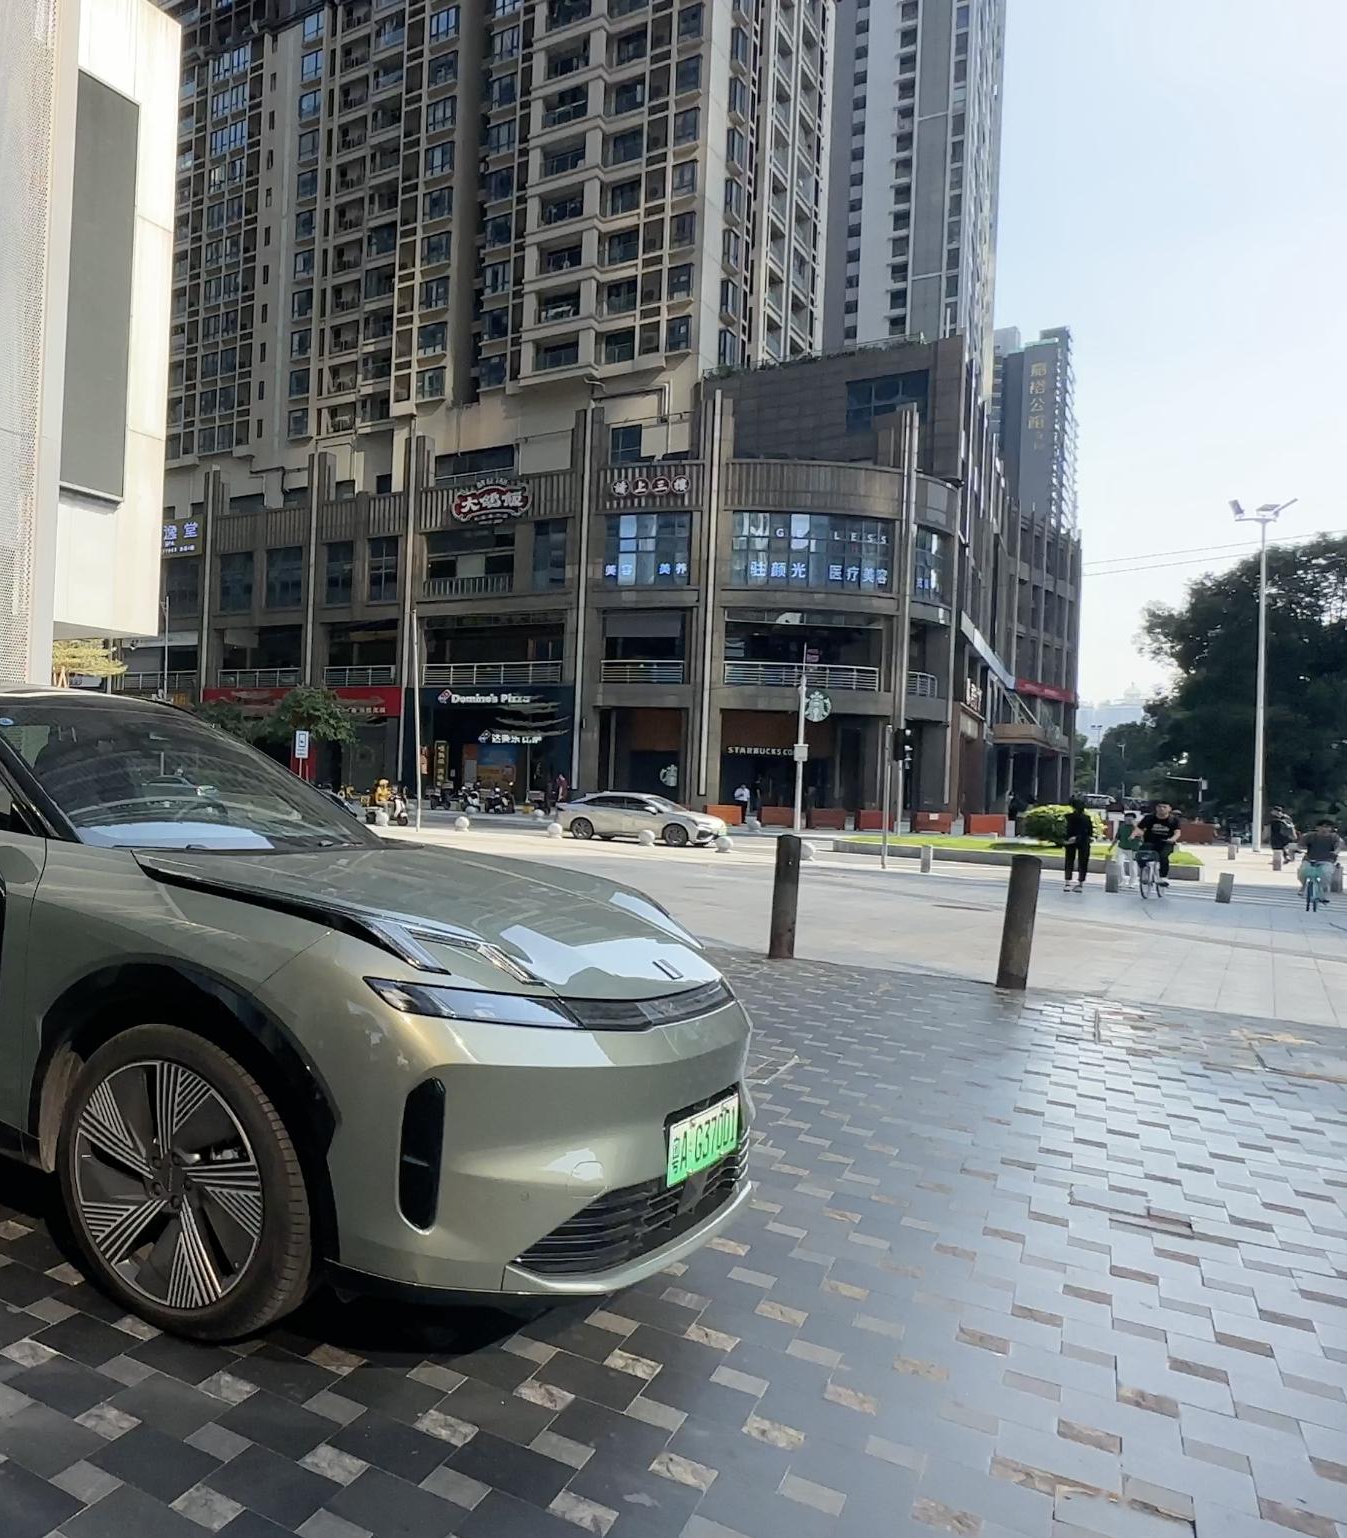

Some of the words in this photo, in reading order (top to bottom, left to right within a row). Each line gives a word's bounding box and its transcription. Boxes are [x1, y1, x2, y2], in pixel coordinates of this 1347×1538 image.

[829, 564, 888, 585] 医疗美容
[450, 693, 499, 704] Domino's
[727, 746, 781, 756] STARBUCKS
